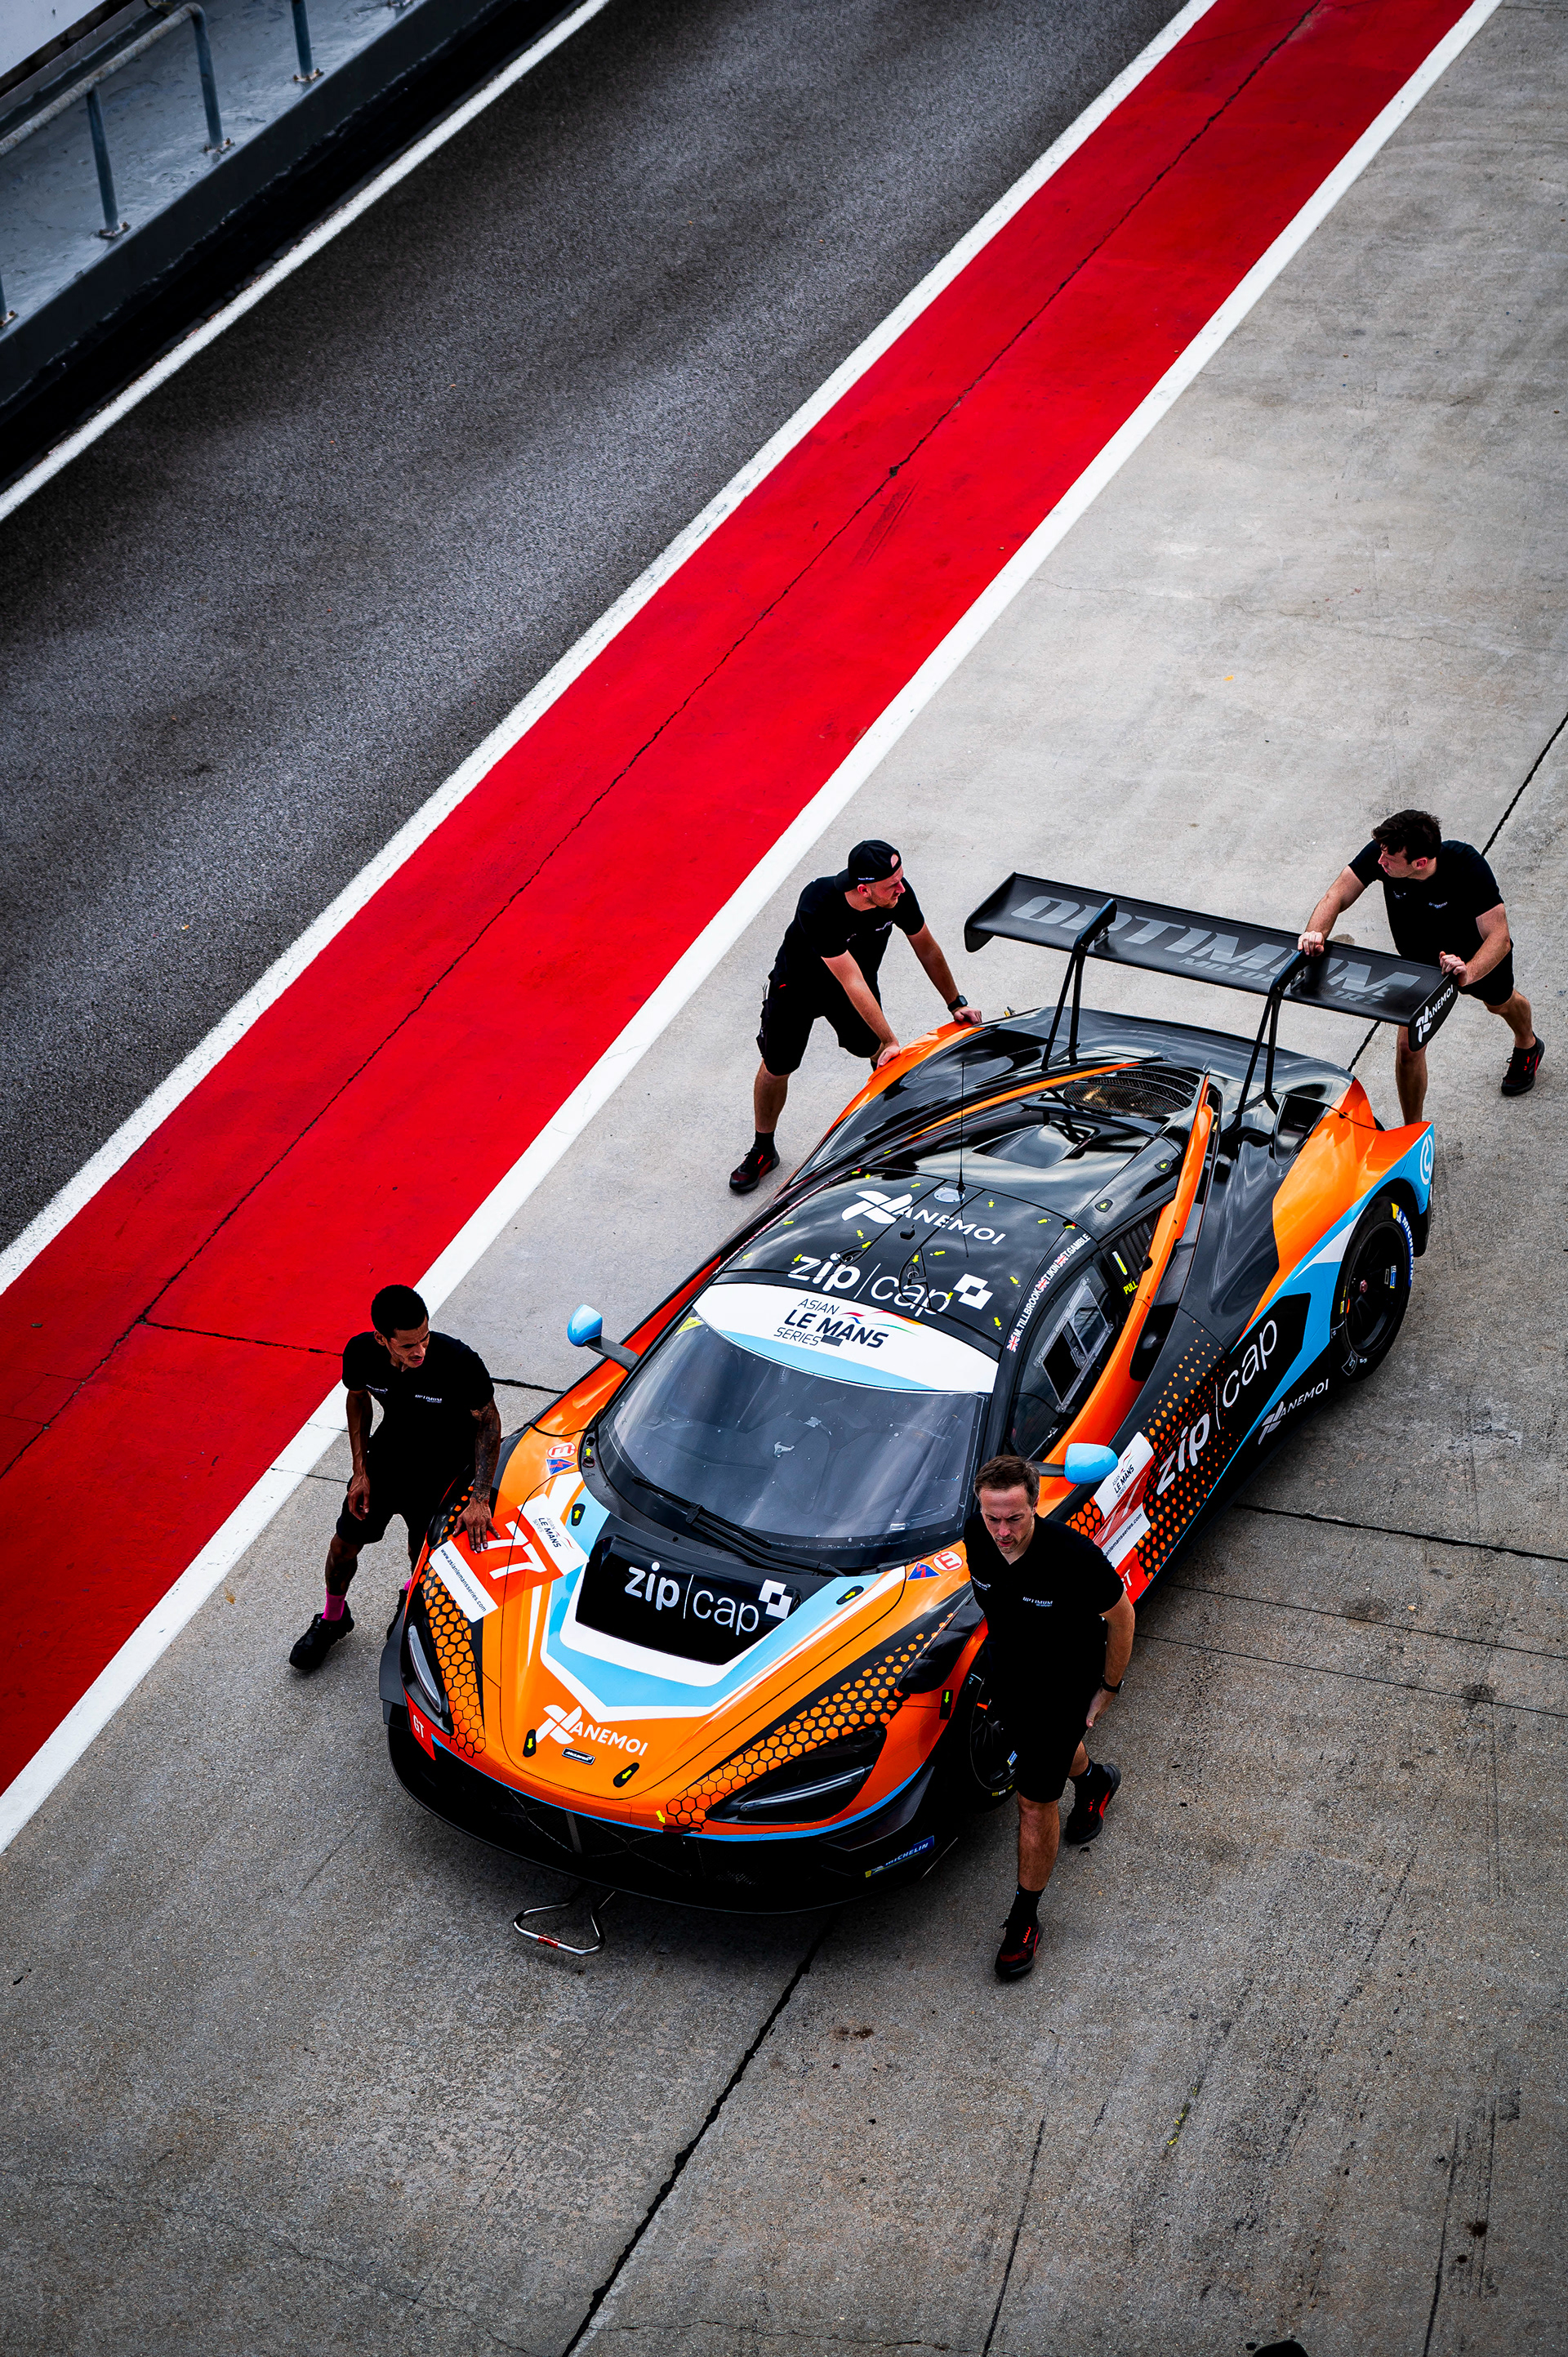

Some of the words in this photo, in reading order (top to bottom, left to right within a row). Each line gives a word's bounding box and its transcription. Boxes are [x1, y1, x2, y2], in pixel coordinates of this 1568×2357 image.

[1430, 984, 1454, 1019] ANEMOI
[893, 1205, 1007, 1245] ANEMOI
[787, 1252, 861, 1292] zip
[871, 1276, 951, 1317] cap
[1123, 1280, 1138, 1295] PULL
[797, 1298, 840, 1316] ASIAN
[773, 1326, 822, 1347] SERIES
[784, 1309, 817, 1330] LE
[815, 1317, 889, 1348] MANS
[1156, 1414, 1210, 1495] zip
[1223, 1320, 1277, 1408] cap
[1280, 1379, 1329, 1418] ANEMOI
[1114, 1482, 1122, 1494] LE
[1120, 1464, 1134, 1486] MANS
[538, 1517, 549, 1526] LE
[543, 1527, 562, 1548] MANS
[1105, 1513, 1143, 1556] anlemansseries.com
[474, 1520, 548, 1580] 77
[440, 1548, 488, 1612] www.asianlemansseries.com
[624, 1561, 680, 1611] zip
[693, 1589, 760, 1636] cap
[413, 1714, 425, 1738] GT
[568, 1721, 649, 1757] ANEMOI
[885, 1842, 929, 1866] MICHELIN
